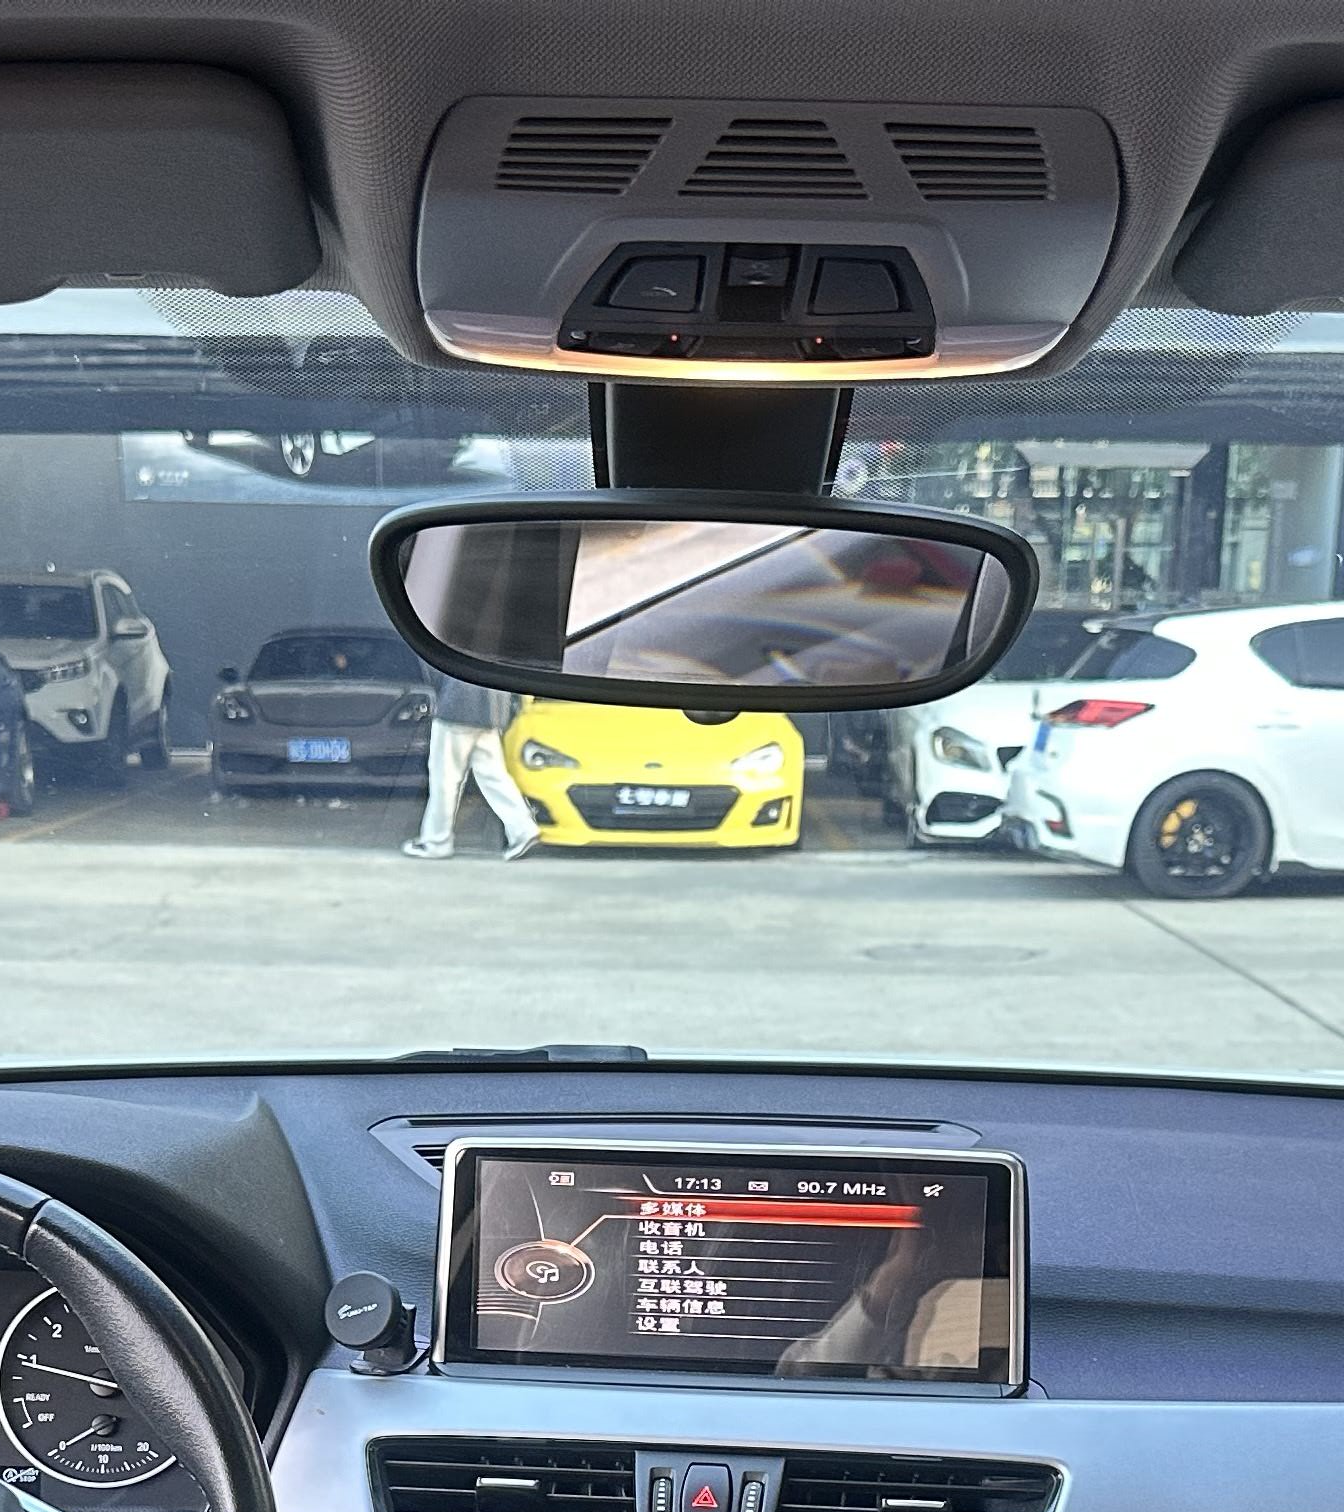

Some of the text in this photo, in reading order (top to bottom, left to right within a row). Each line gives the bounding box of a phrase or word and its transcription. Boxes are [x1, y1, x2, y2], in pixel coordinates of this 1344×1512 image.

[674, 1177, 722, 1190] 17:13
[797, 1181, 886, 1196] 90.7 MHz
[639, 1202, 707, 1217] 多媒体
[638, 1221, 706, 1237] 收音机
[639, 1240, 683, 1255] 电话
[638, 1260, 705, 1276] 联系人
[637, 1278, 727, 1295] 互联驾驶
[636, 1298, 725, 1314] 车辆信息
[52, 1324, 62, 1338] 2
[636, 1316, 680, 1332] 设置
[29, 1354, 38, 1364] 1
[37, 1413, 55, 1422] OFF
[59, 1441, 66, 1450] 0
[137, 1441, 150, 1452] 20
[97, 1454, 109, 1464] 10
